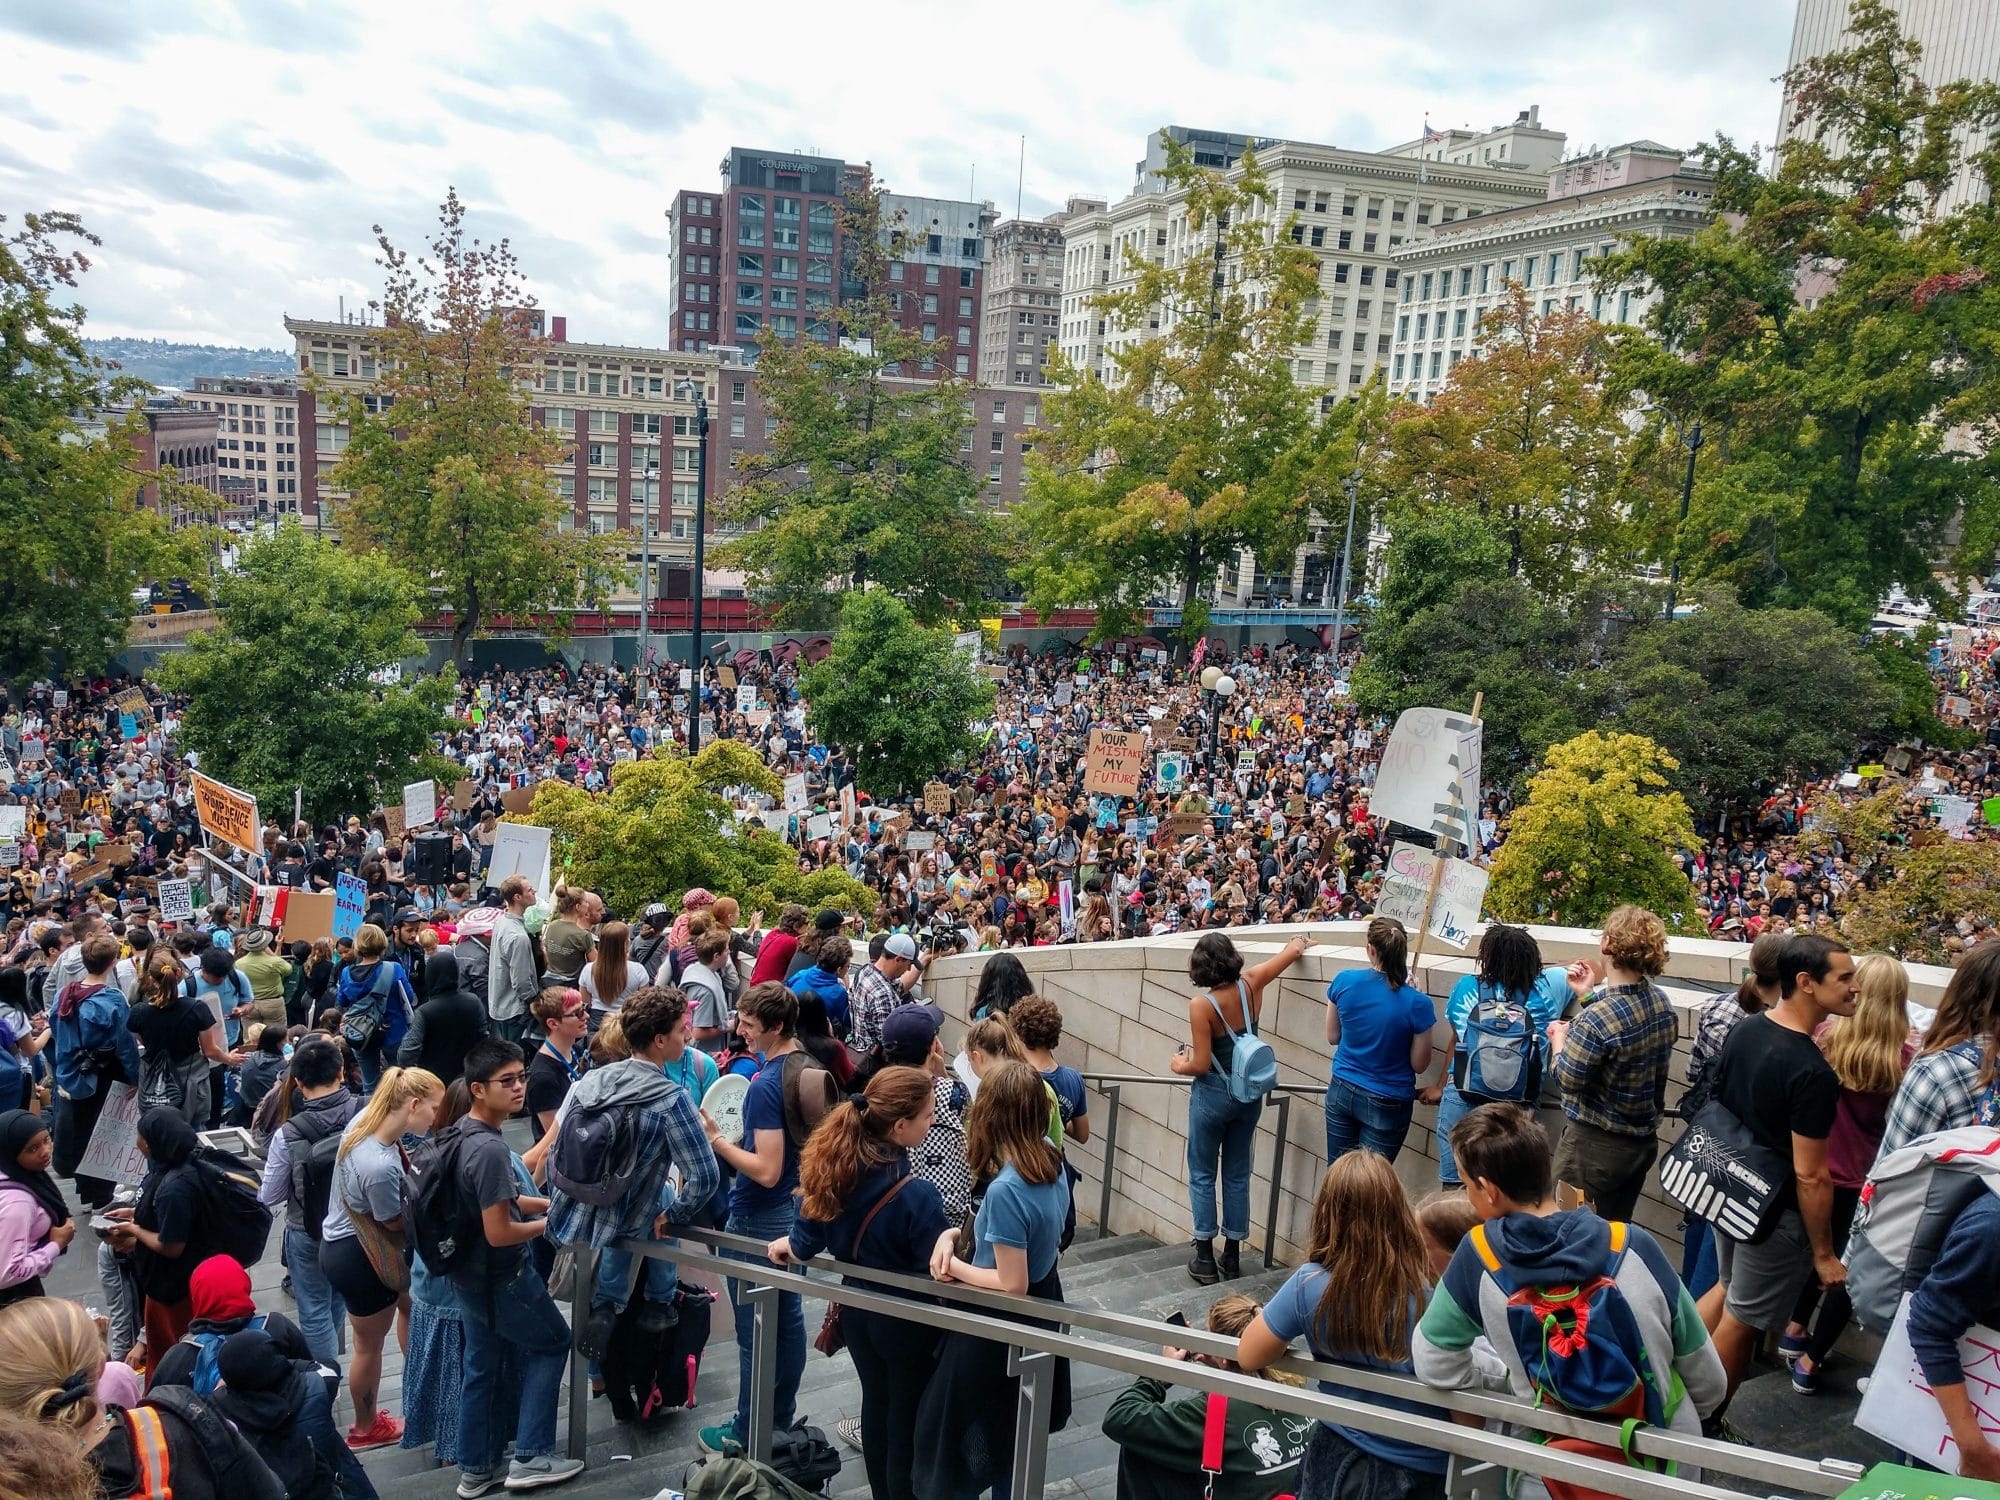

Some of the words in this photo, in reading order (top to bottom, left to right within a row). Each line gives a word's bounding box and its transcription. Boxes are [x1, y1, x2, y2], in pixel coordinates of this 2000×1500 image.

[760, 159, 818, 173] COURTYARD
[1101, 732, 1127, 746] YOUR
[1093, 745, 1141, 758] MISTAKE
[1103, 758, 1123, 770] MY
[1092, 770, 1135, 785] FUTURE
[338, 874, 366, 894] JUSTICE
[162, 894, 189, 902] ACTION
[348, 892, 353, 900] 4
[163, 901, 190, 911] SPEED
[337, 898, 362, 915] EARTH
[346, 914, 351, 922] 4
[1380, 897, 1404, 918] Care
[1406, 903, 1421, 920] for
[1439, 911, 1470, 945] Home
[83, 1138, 111, 1166] PASS
[111, 1146, 124, 1169] A
[125, 1147, 145, 1176] BIL
[1288, 1445, 1305, 1458] MDA
